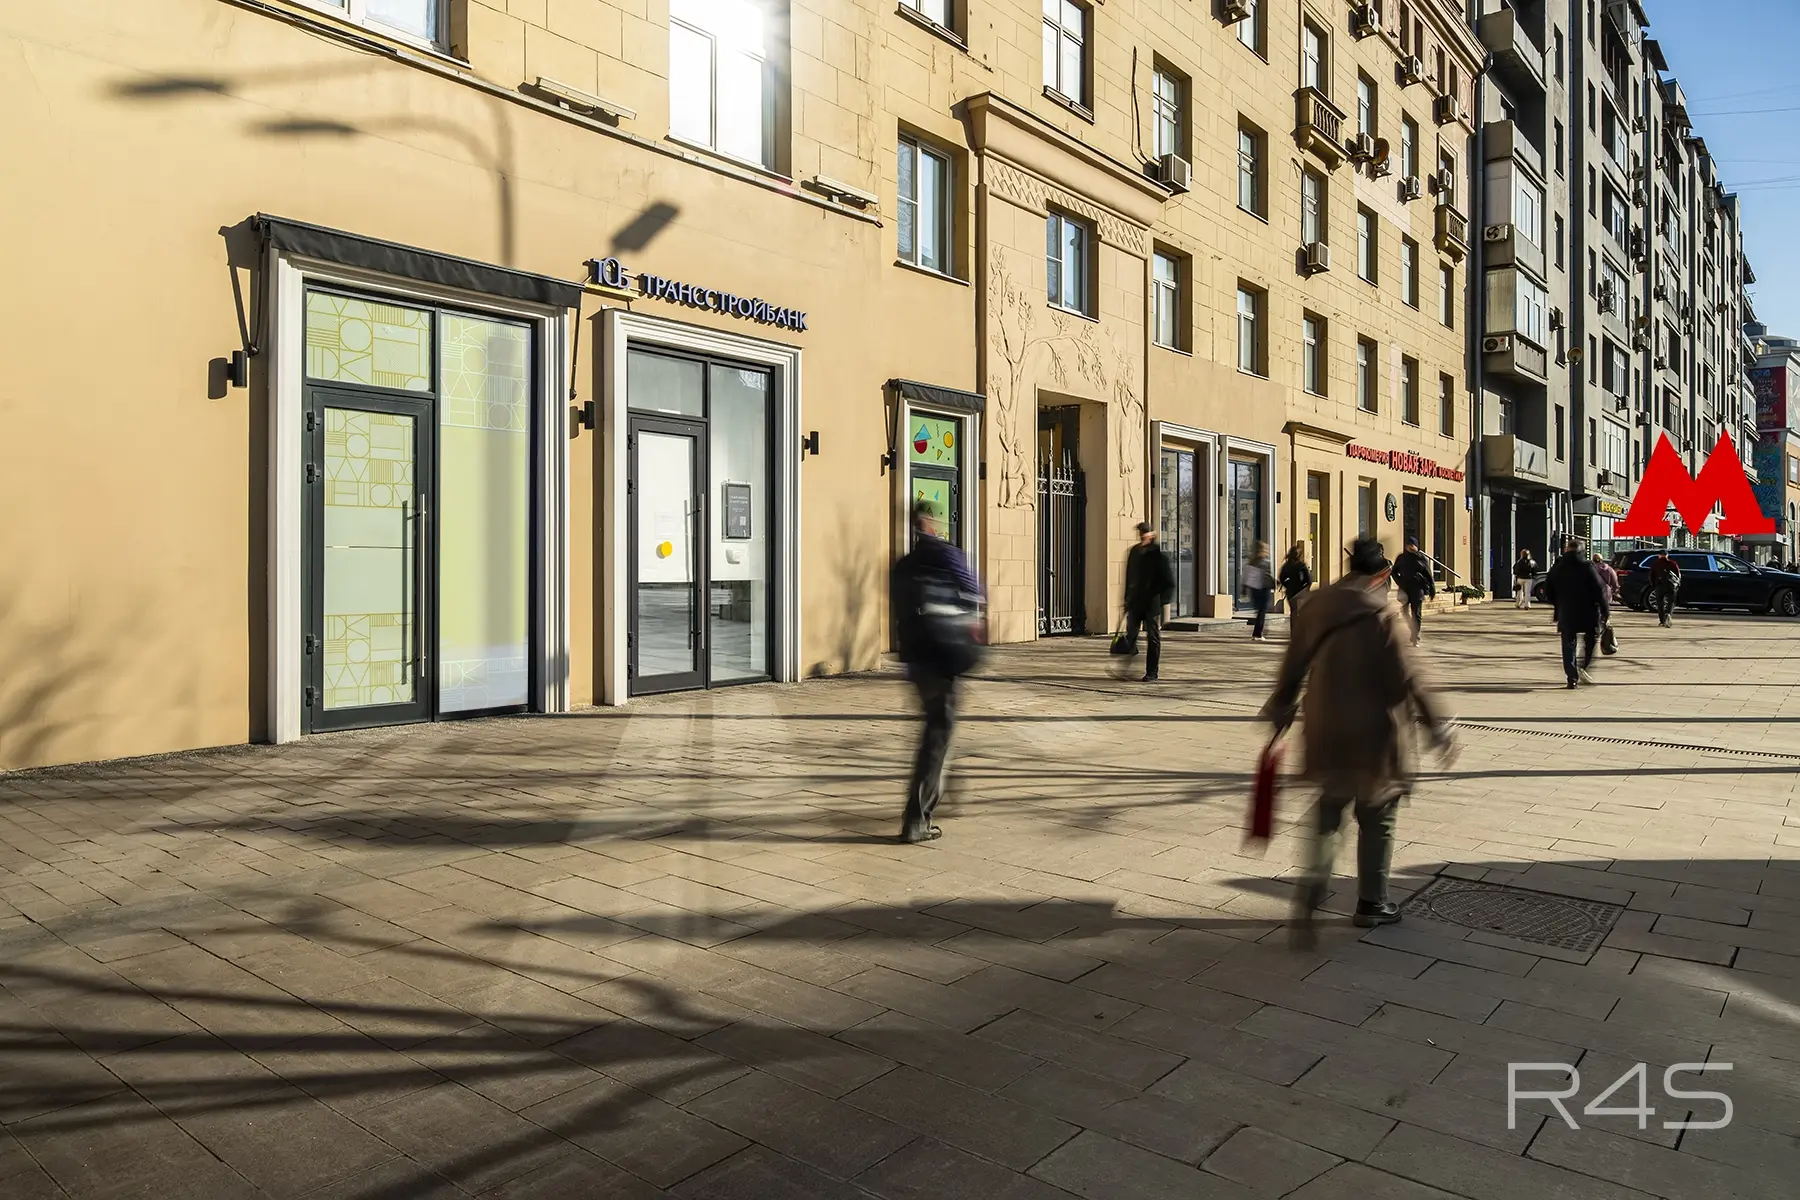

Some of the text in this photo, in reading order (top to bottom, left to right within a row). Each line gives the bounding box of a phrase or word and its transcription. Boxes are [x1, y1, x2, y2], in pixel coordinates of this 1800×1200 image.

[641, 272, 809, 332] ТРАНССТРОЙБАНК
[1390, 450, 1419, 474] НОВАЯ
[1419, 456, 1437, 478] ЗАРЯ
